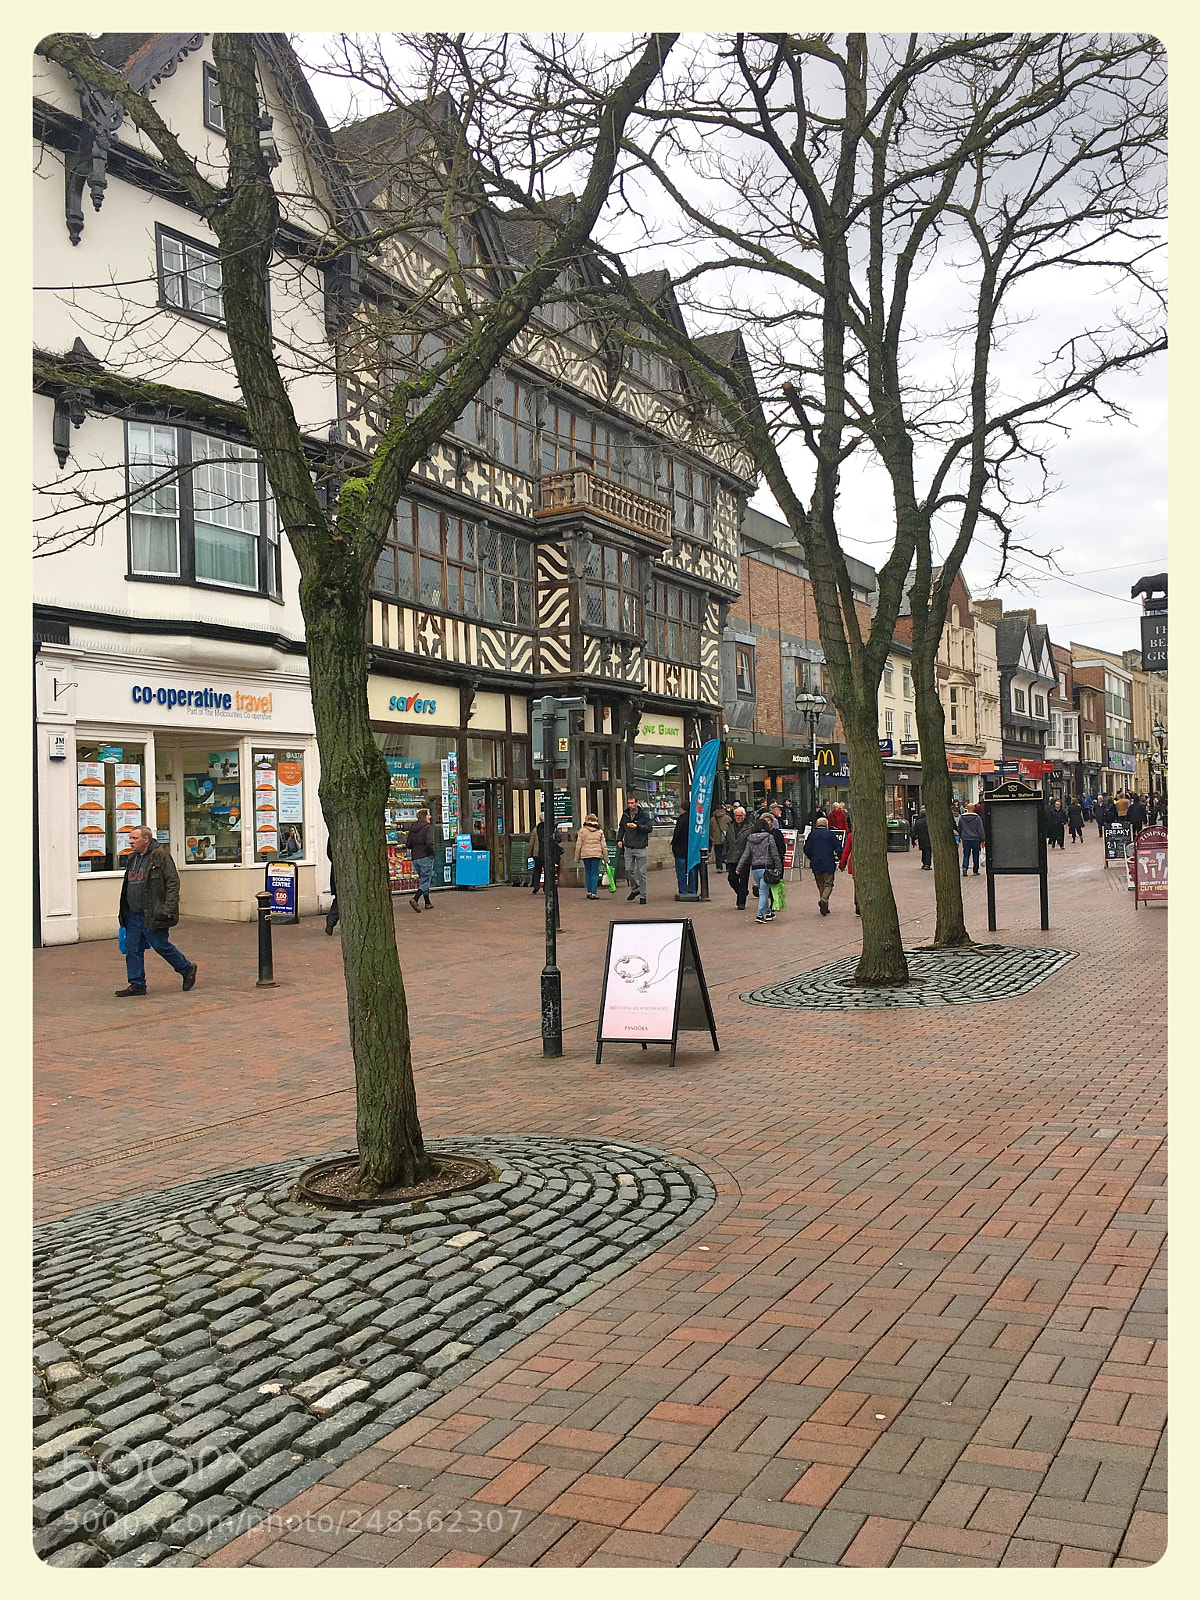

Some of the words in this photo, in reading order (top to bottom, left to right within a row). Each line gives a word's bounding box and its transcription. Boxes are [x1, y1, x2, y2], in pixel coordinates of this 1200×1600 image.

[1150, 638, 1168, 648] BE
[132, 685, 232, 710] co-operative
[236, 690, 273, 713] travel
[389, 692, 437, 714] savers
[204, 708, 214, 717] The
[658, 723, 680, 736] GIANT
[55, 737, 65, 745] JM
[695, 775, 707, 834] savers
[1105, 828, 1130, 838] FREAKY
[1139, 830, 1168, 842] TIMPSO
